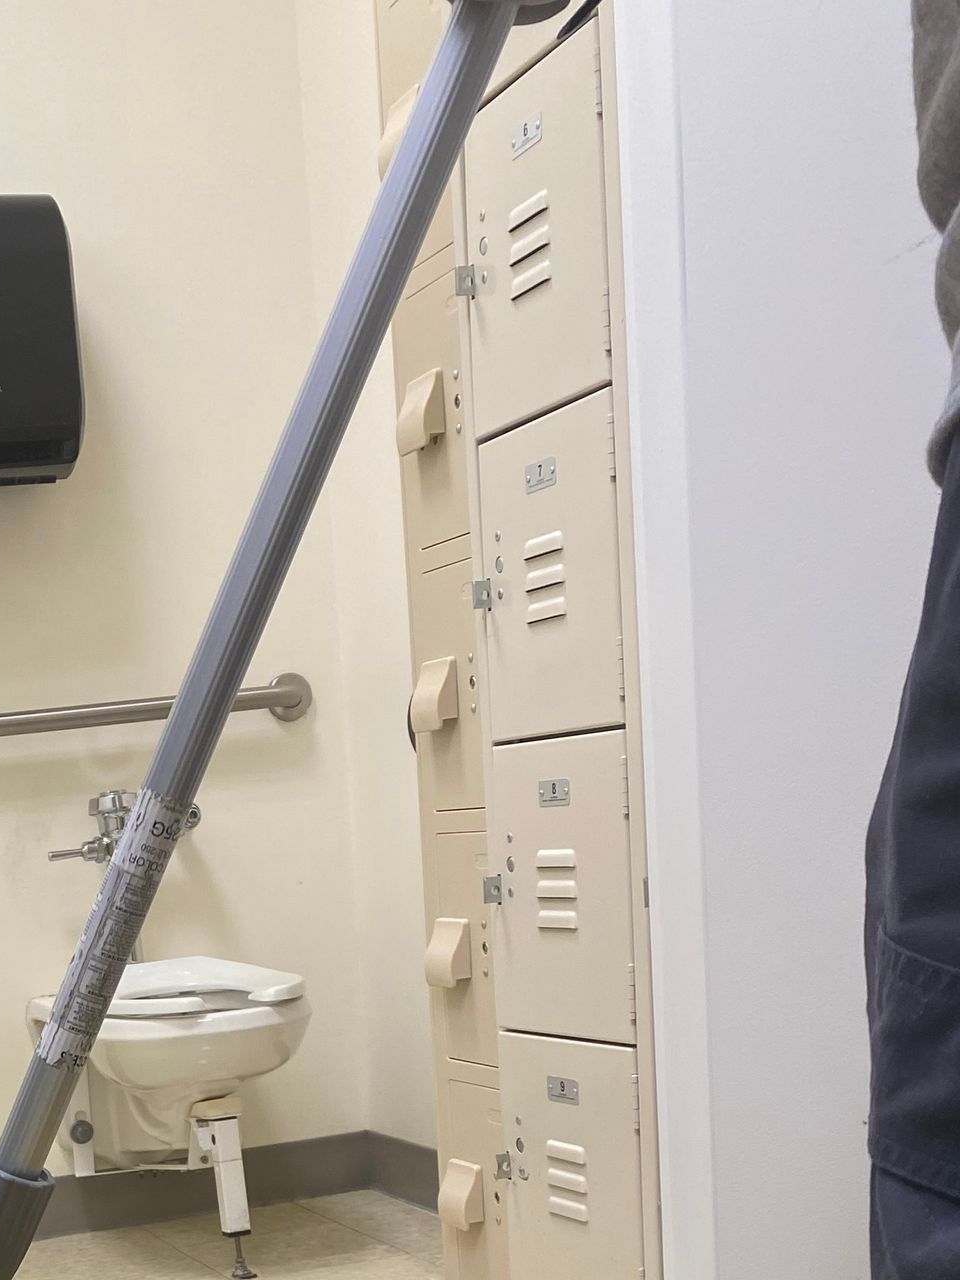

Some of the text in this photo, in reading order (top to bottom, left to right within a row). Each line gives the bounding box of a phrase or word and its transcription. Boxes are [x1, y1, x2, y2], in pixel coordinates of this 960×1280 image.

[523, 122, 528, 137] 6
[551, 782, 557, 795] 8
[559, 1080, 565, 1092] 9
